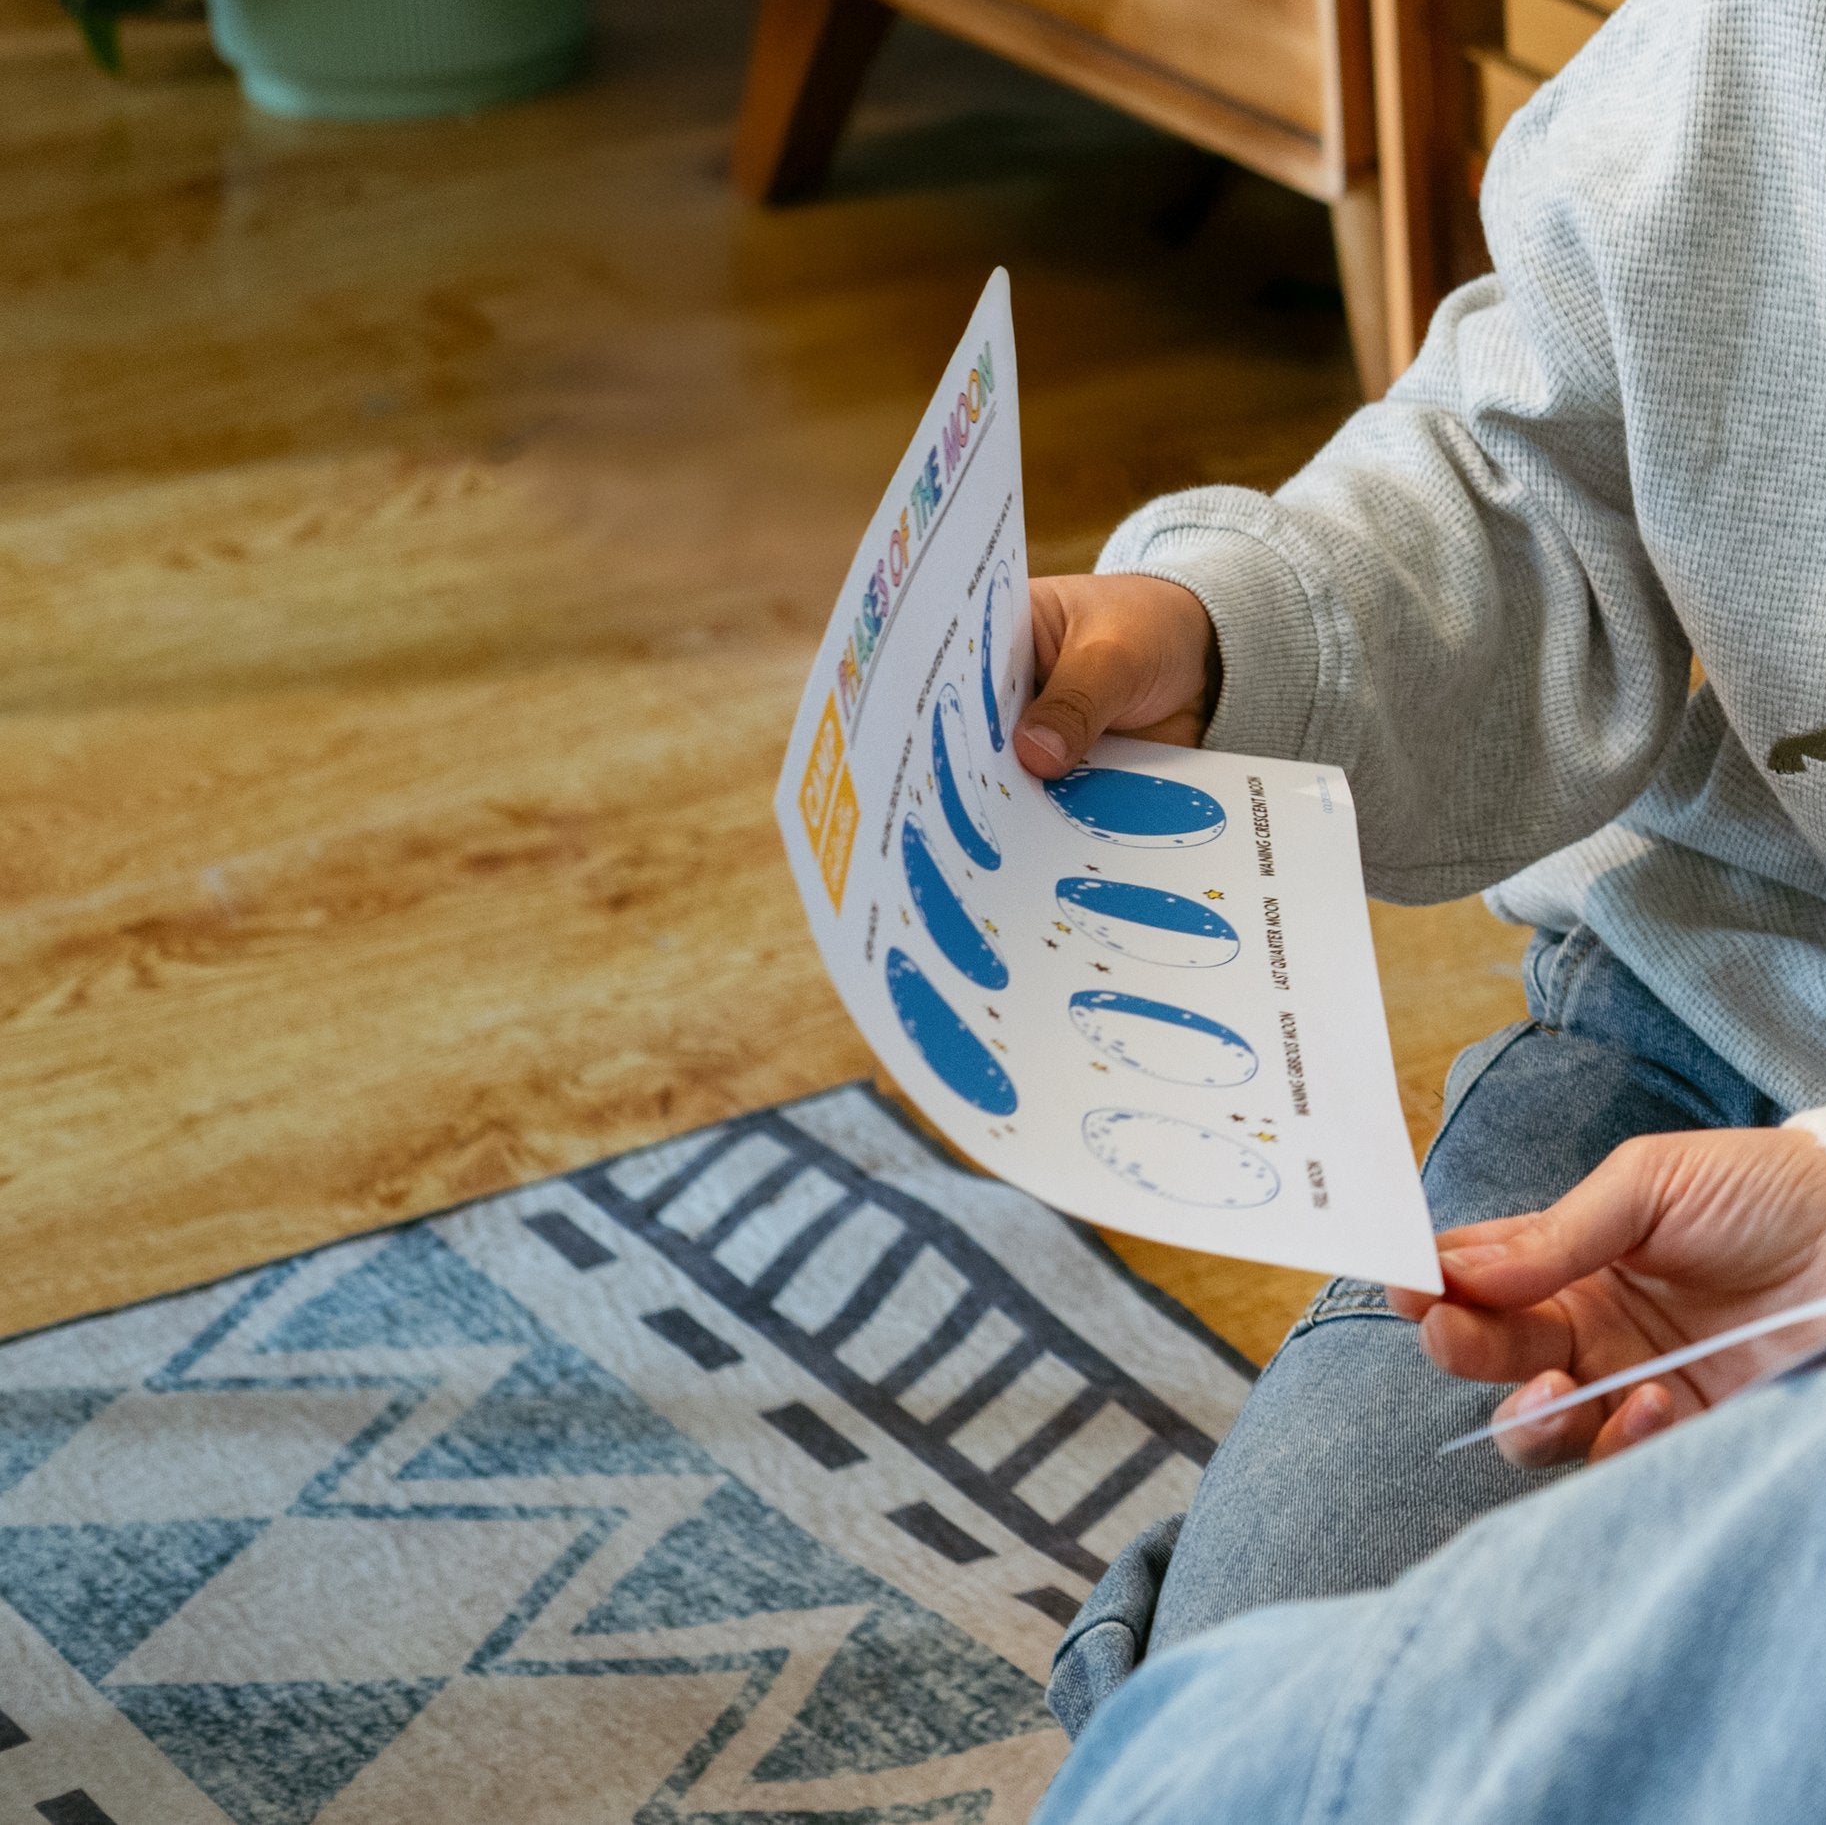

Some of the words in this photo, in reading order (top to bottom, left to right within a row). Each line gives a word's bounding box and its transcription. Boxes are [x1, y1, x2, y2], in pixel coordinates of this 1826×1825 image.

[837, 558, 889, 720] PHASES
[889, 507, 910, 587] OF
[911, 445, 942, 541] THE
[943, 340, 994, 484] MOON
[1251, 798, 1271, 838] CRESCENT
[1256, 840, 1275, 877] WANING
[1263, 897, 1281, 927] MOON
[1266, 929, 1287, 969] QUARTER
[1271, 970, 1290, 990] LAST
[1279, 1011, 1298, 1039] MOON
